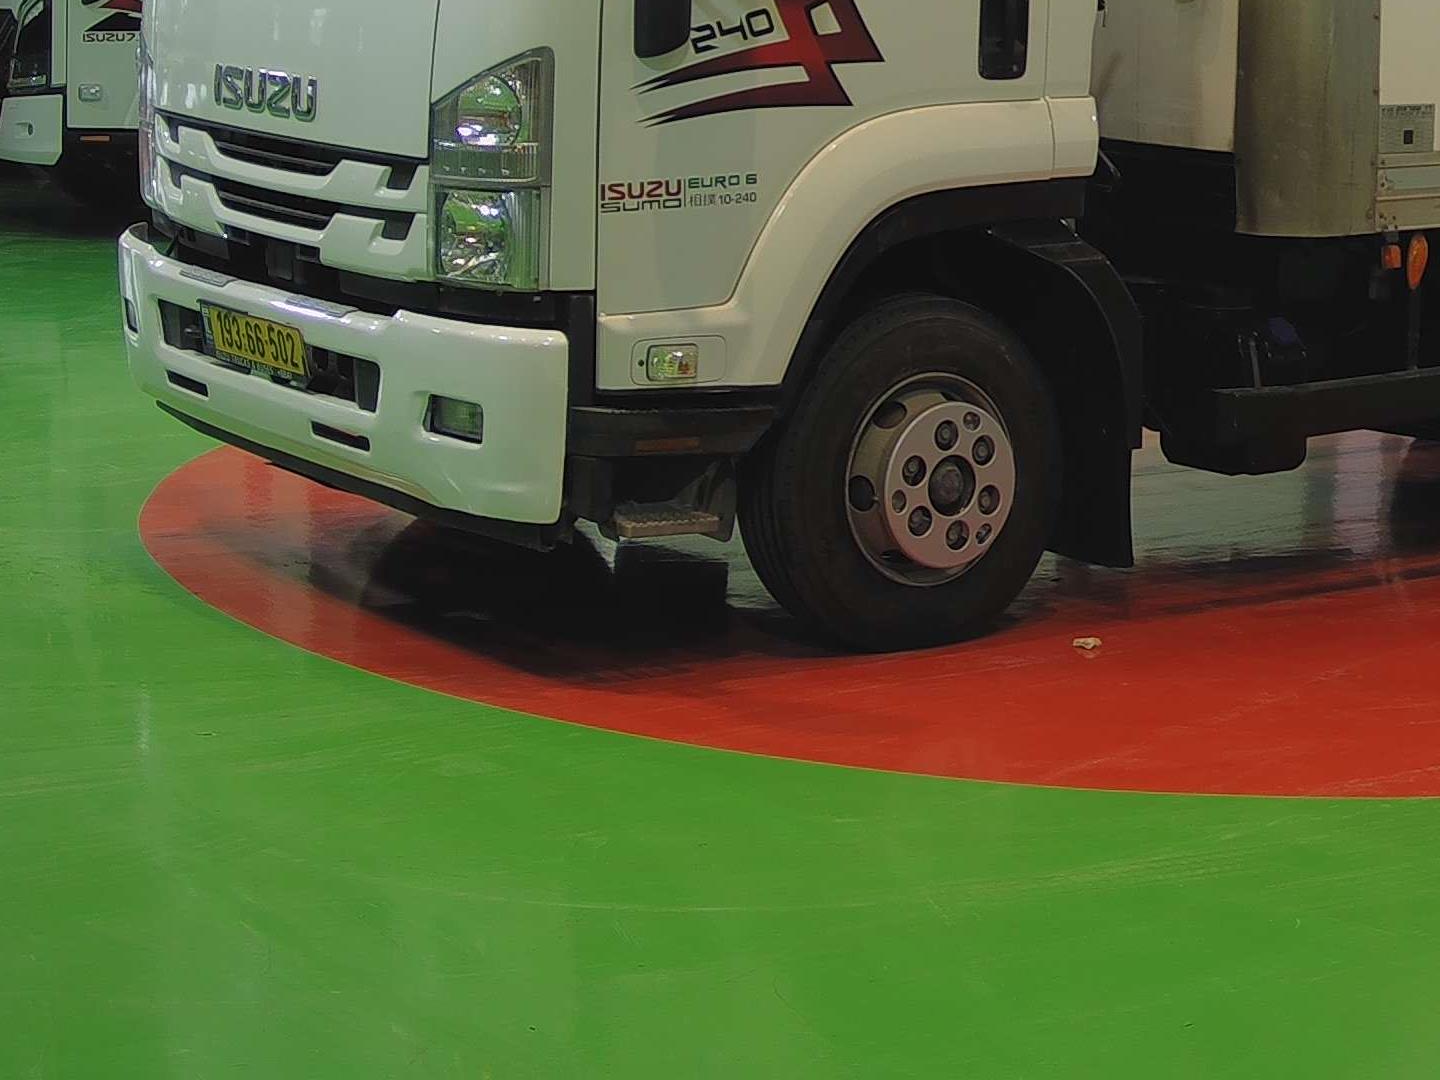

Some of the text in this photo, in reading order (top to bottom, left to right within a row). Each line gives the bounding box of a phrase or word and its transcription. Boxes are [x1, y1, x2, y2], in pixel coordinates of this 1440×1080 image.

[690, 7, 775, 55] 240
[213, 63, 318, 123] ISUZU
[600, 178, 682, 202] ISUZU
[687, 173, 758, 189] EURO 6
[600, 197, 682, 214] SUMO
[718, 191, 758, 206] 10-240
